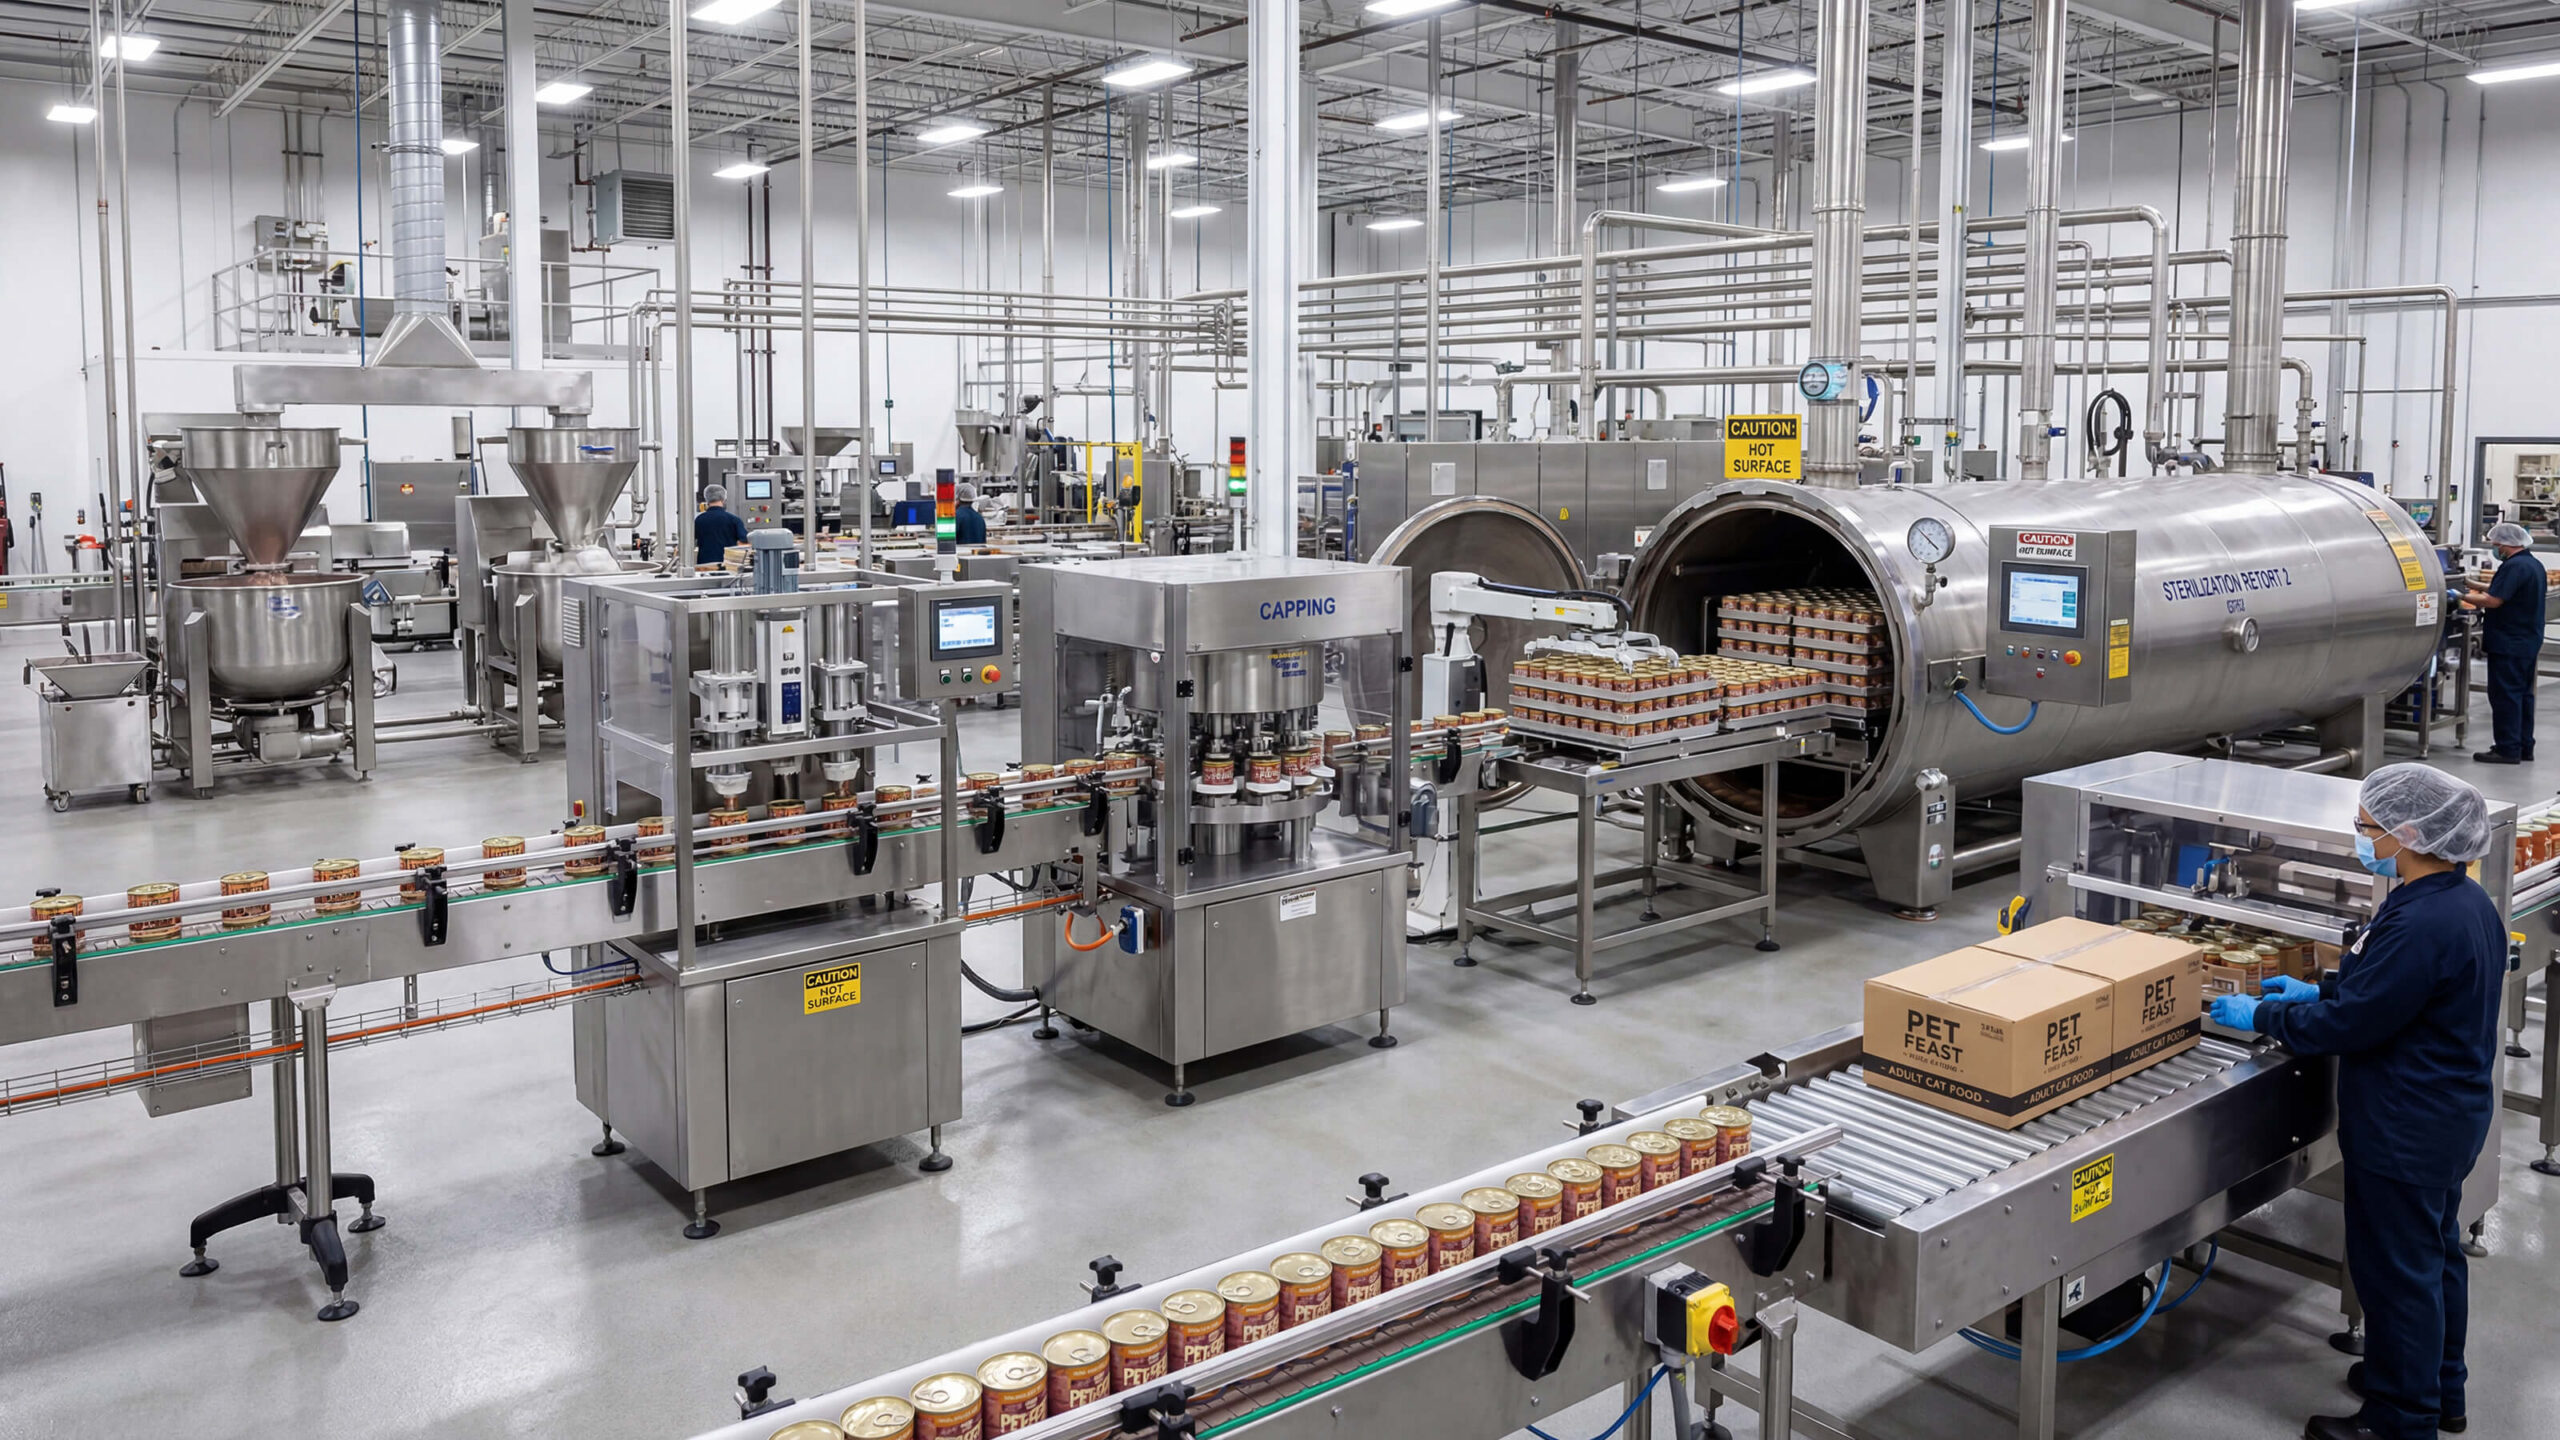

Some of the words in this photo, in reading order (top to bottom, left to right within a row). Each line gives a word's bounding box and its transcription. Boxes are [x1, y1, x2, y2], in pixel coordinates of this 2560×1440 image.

[1731, 421, 1795, 436] CAUTION:
[1749, 443, 1775, 456] HOT
[1734, 459, 1791, 473] SURFACE
[2023, 534, 2070, 545] CAUTION
[2163, 573, 2243, 601] STERILIZATION
[2240, 568, 2282, 591] RETORT
[2282, 567, 2292, 586] 2
[1260, 597, 1336, 620] CAPPING
[806, 967, 858, 987] CAUTION
[808, 991, 857, 1009] SURFACE
[2145, 975, 2175, 1007] PET
[2142, 998, 2176, 1025] FEAST
[1908, 1009, 1960, 1044] PET
[2047, 1012, 2081, 1047] PET
[1905, 1033, 1963, 1063] FEAST
[2044, 1036, 2082, 1065] FEAST
[1888, 1066, 1923, 1083] ADULT
[1925, 1077, 1948, 1091] CAT
[2029, 1084, 2056, 1104] ADULT
[2056, 1077, 2072, 1092] CAT
[1184, 1345, 1209, 1363] PET
[1124, 1367, 1150, 1387] PET
